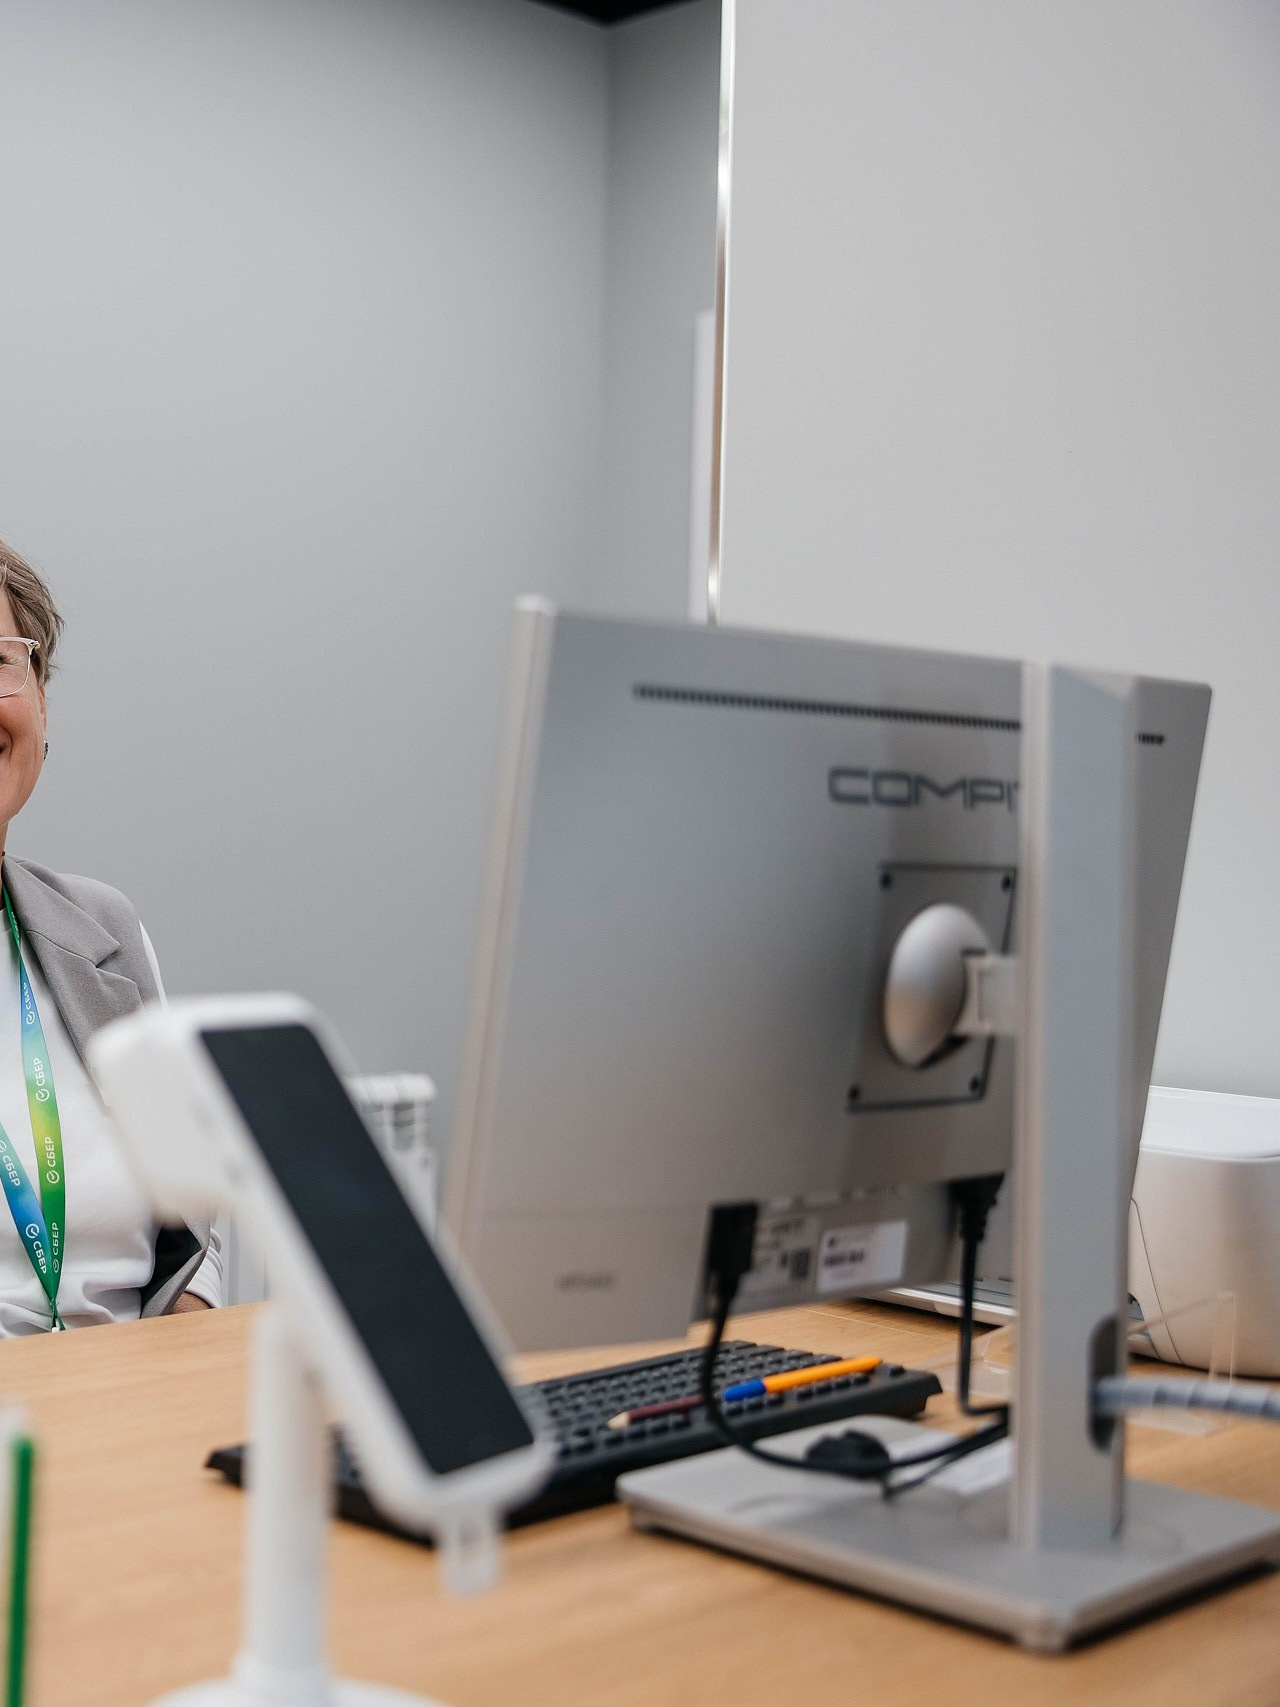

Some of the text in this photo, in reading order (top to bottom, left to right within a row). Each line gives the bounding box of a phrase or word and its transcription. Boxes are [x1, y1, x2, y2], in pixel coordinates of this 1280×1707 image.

[34, 1057, 46, 1087] СБЕР
[44, 1136, 56, 1168] СБЕР
[2, 1155, 21, 1187] СБЕР
[33, 1242, 47, 1274] СБЕР
